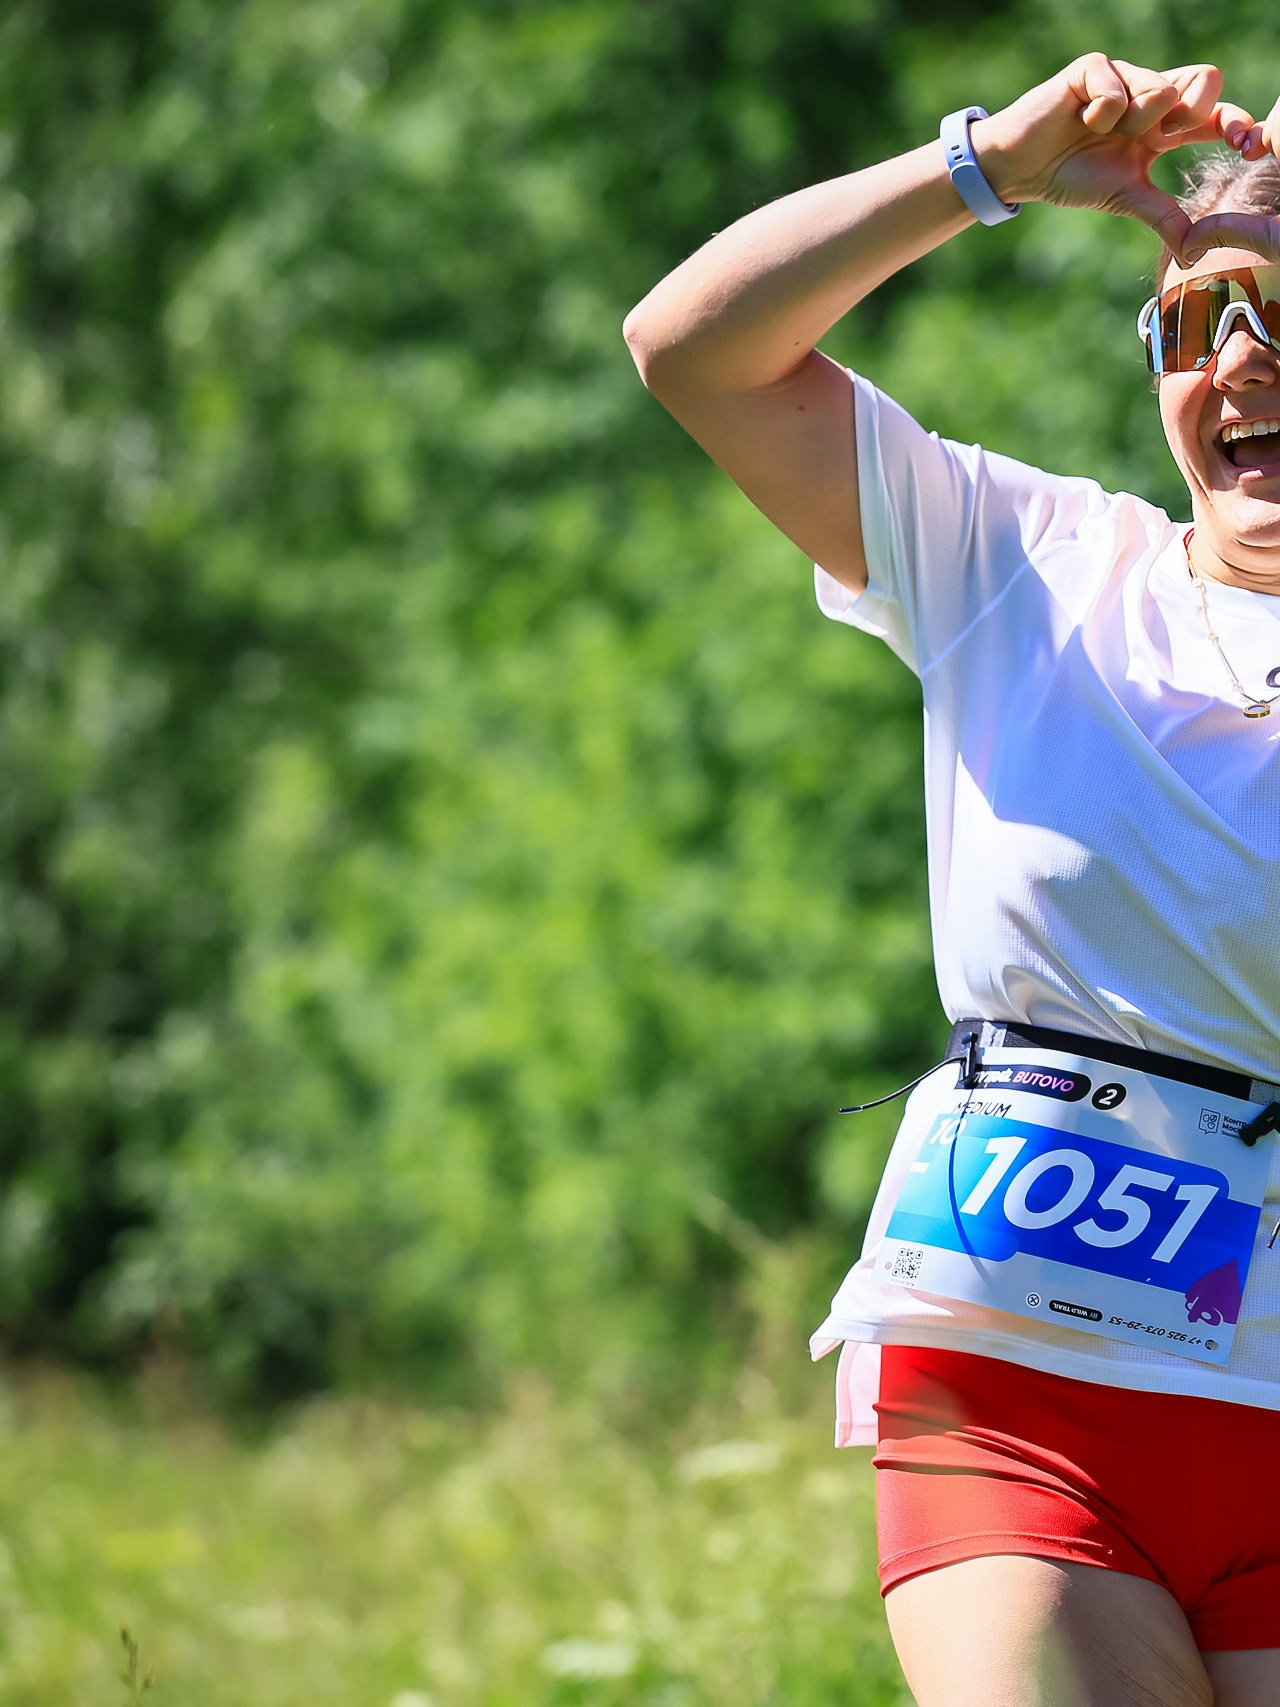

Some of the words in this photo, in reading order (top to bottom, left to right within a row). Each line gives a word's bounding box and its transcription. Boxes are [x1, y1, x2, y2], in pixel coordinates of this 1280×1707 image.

[1013, 1070, 1075, 1093] BUTOVO
[1098, 1087, 1119, 1106] 2
[951, 1101, 1012, 1118] MEDIUM
[959, 1135, 1220, 1263] 1051
[1052, 1302, 1071, 1312] TRAIL
[1071, 1307, 1088, 1317] WILD
[1108, 1316, 1166, 1336] 073-29-53
[1166, 1330, 1188, 1342] 925
[1187, 1336, 1202, 1345] +7
